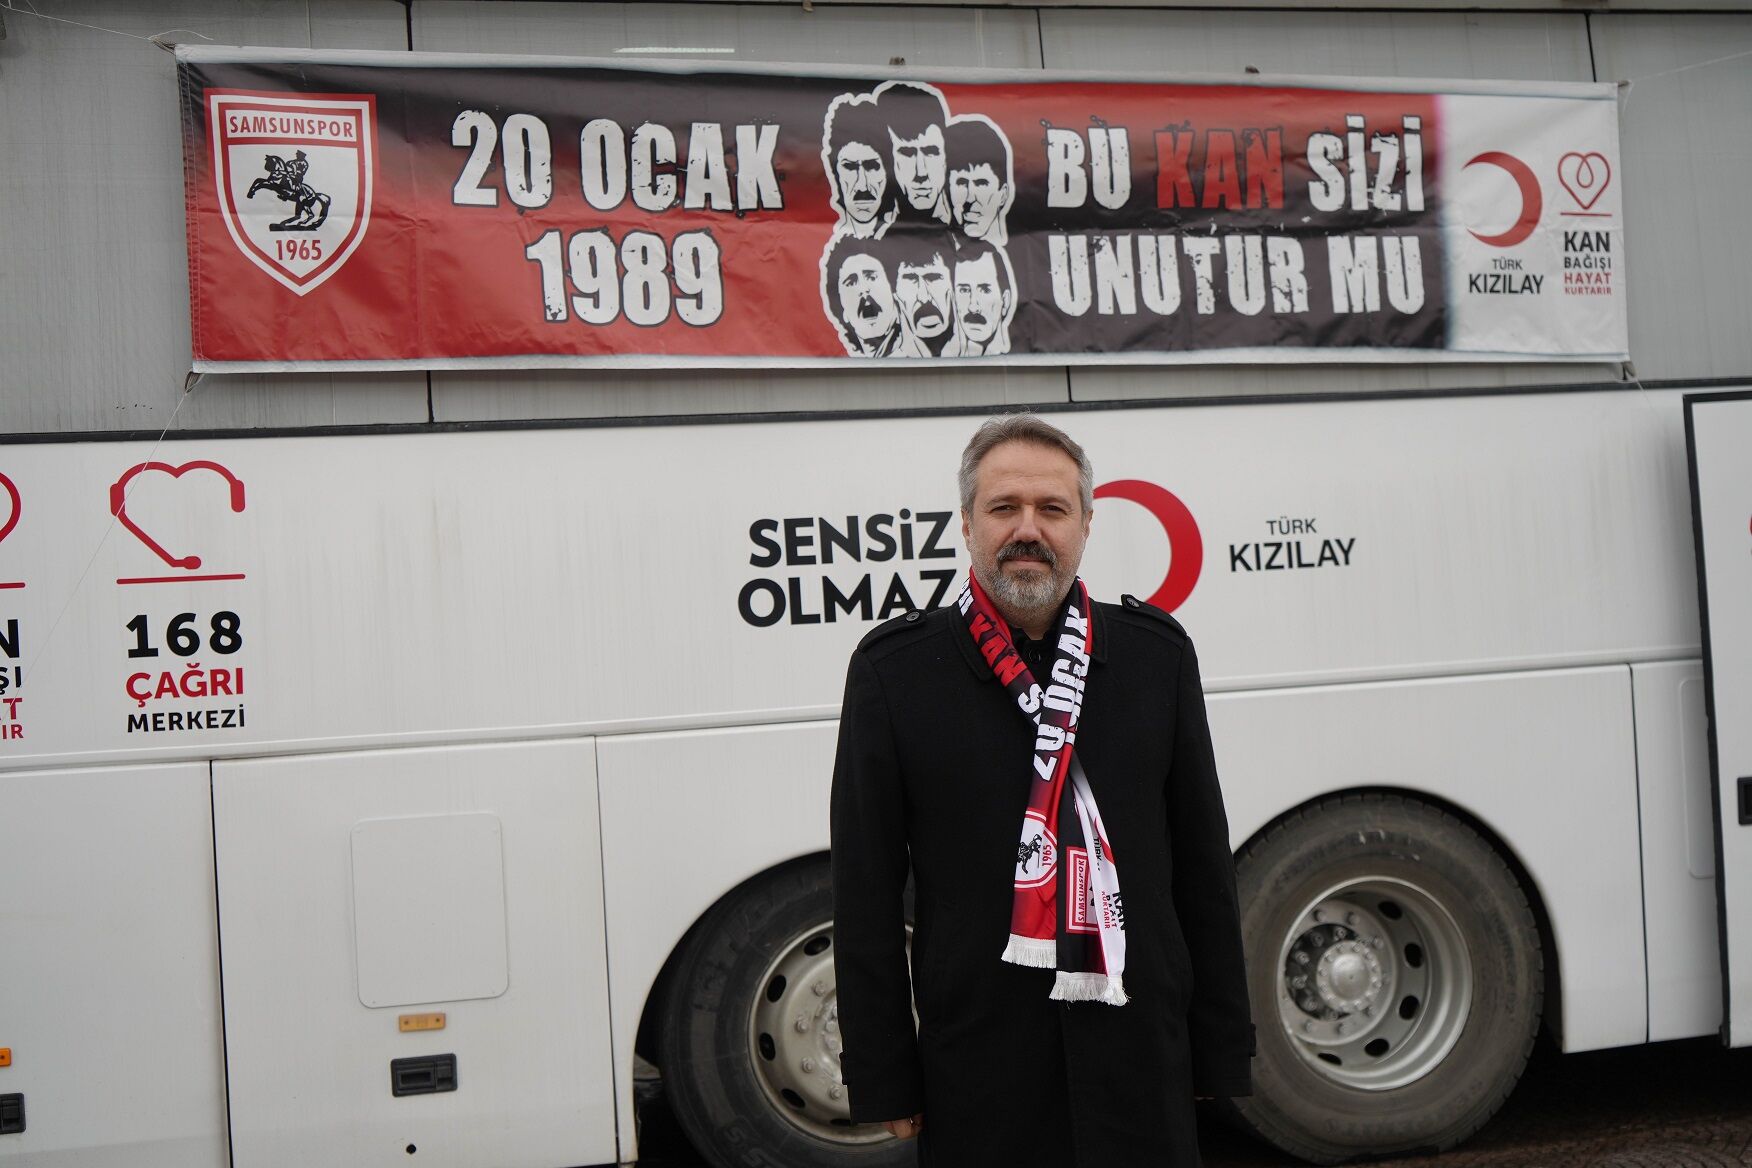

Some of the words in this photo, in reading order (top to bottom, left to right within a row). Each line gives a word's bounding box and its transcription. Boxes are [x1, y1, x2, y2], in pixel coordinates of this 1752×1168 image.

[229, 115, 354, 138] SAMSUNSPOR
[451, 109, 553, 209] 20
[581, 117, 785, 212] OCAK
[1047, 126, 1132, 210] BU
[1154, 127, 1285, 210] KAN
[1306, 114, 1425, 212] SİZİ
[275, 239, 322, 261] 1965
[1564, 231, 1611, 253] KAN
[1048, 234, 1310, 316] UNUTUR
[1328, 234, 1425, 315] MU
[1492, 256, 1523, 271] TÜRK
[1564, 254, 1612, 272] BAĞIŞI
[525, 229, 725, 327] 1989
[1469, 273, 1544, 295] KIZILAY
[1564, 272, 1612, 285] HAYAT
[1565, 286, 1612, 296] KURTARIR
[1265, 515, 1318, 536] TÜRK
[1229, 537, 1357, 573] KIZILAY
[738, 568, 957, 628] OLMAZ
[125, 610, 243, 659] 168
[969, 612, 1028, 687] KAN
[125, 662, 244, 708] ÇAĞRI
[127, 704, 245, 733] MERKEZİ
[1042, 844, 1052, 867] 1965
